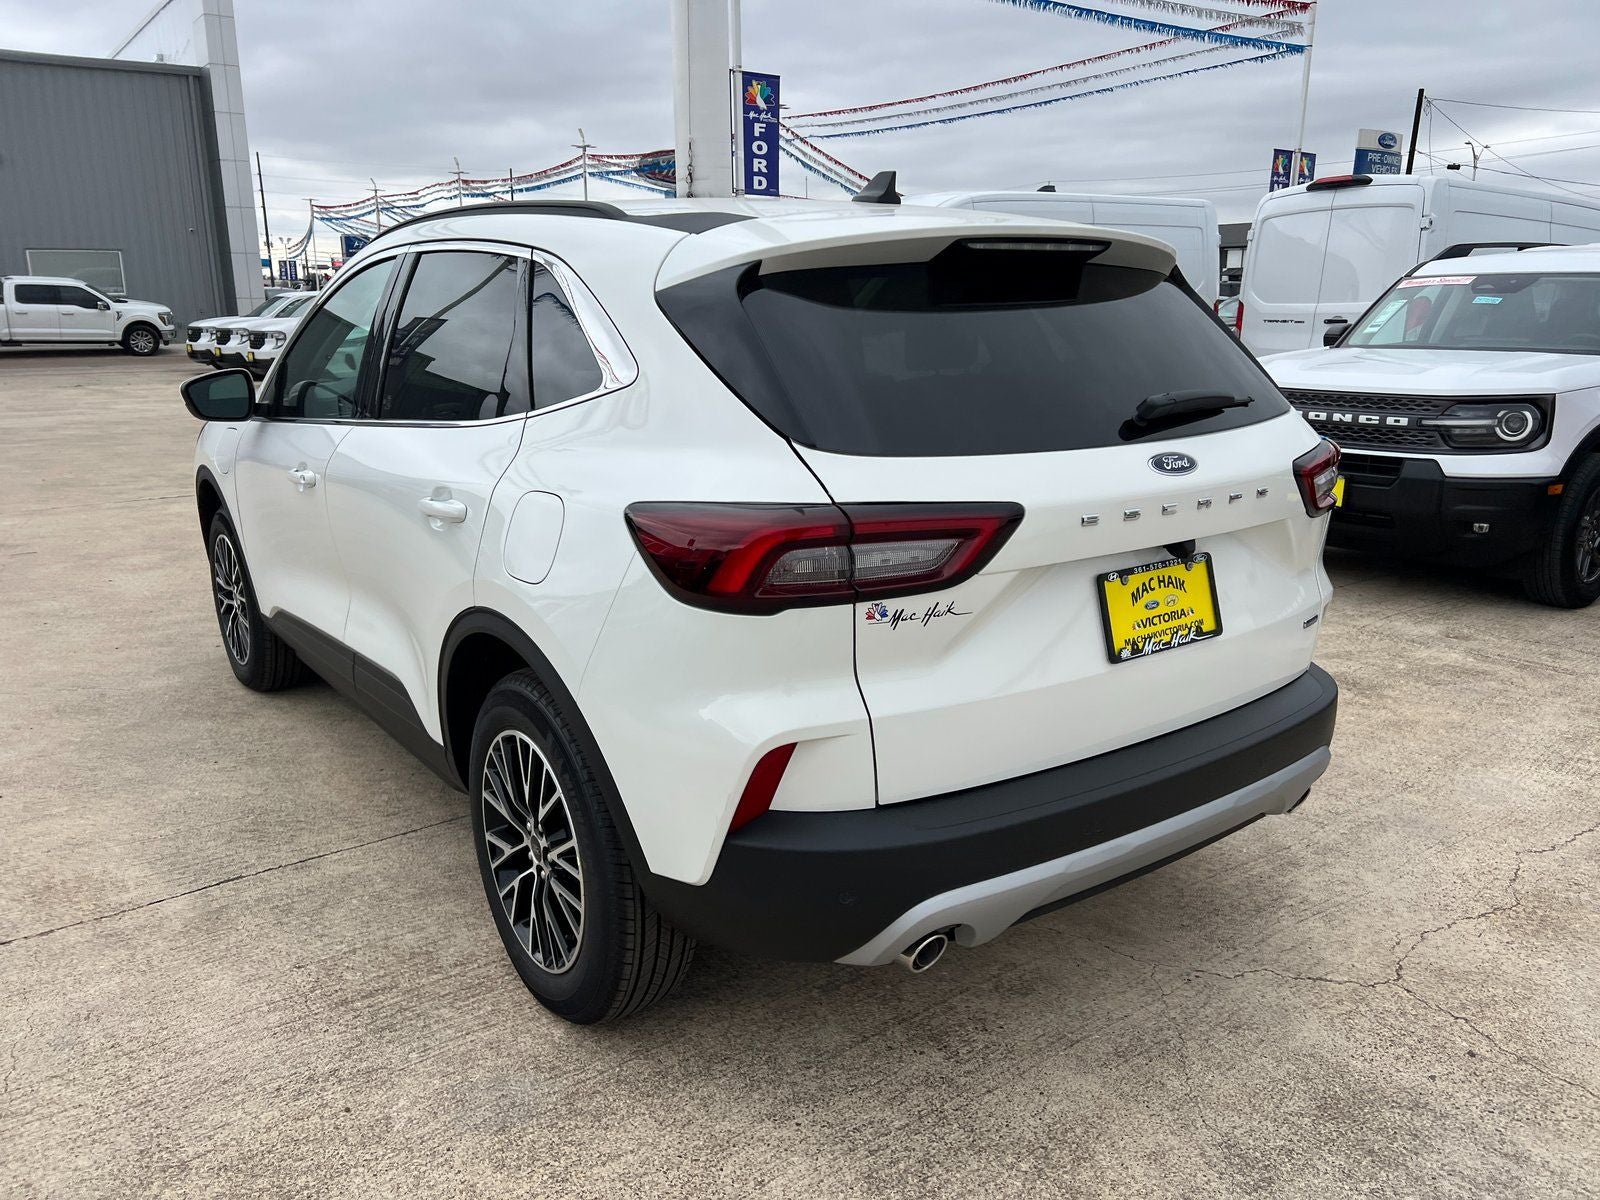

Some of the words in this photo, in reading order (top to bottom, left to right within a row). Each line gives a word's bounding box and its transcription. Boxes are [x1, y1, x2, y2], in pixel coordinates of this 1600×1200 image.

[752, 122, 768, 190] FORD
[1298, 410, 1409, 426] ONCO
[1162, 455, 1190, 470] Ford
[1081, 486, 1269, 526] ESCAPE
[1131, 577, 1156, 606] MAC
[1157, 574, 1187, 593] HAIK
[887, 609, 920, 630] Mac
[921, 601, 973, 627] Haik
[1140, 608, 1187, 629] VICTORIA
[1141, 637, 1170, 655] Mac
[1171, 627, 1213, 647] Haik
